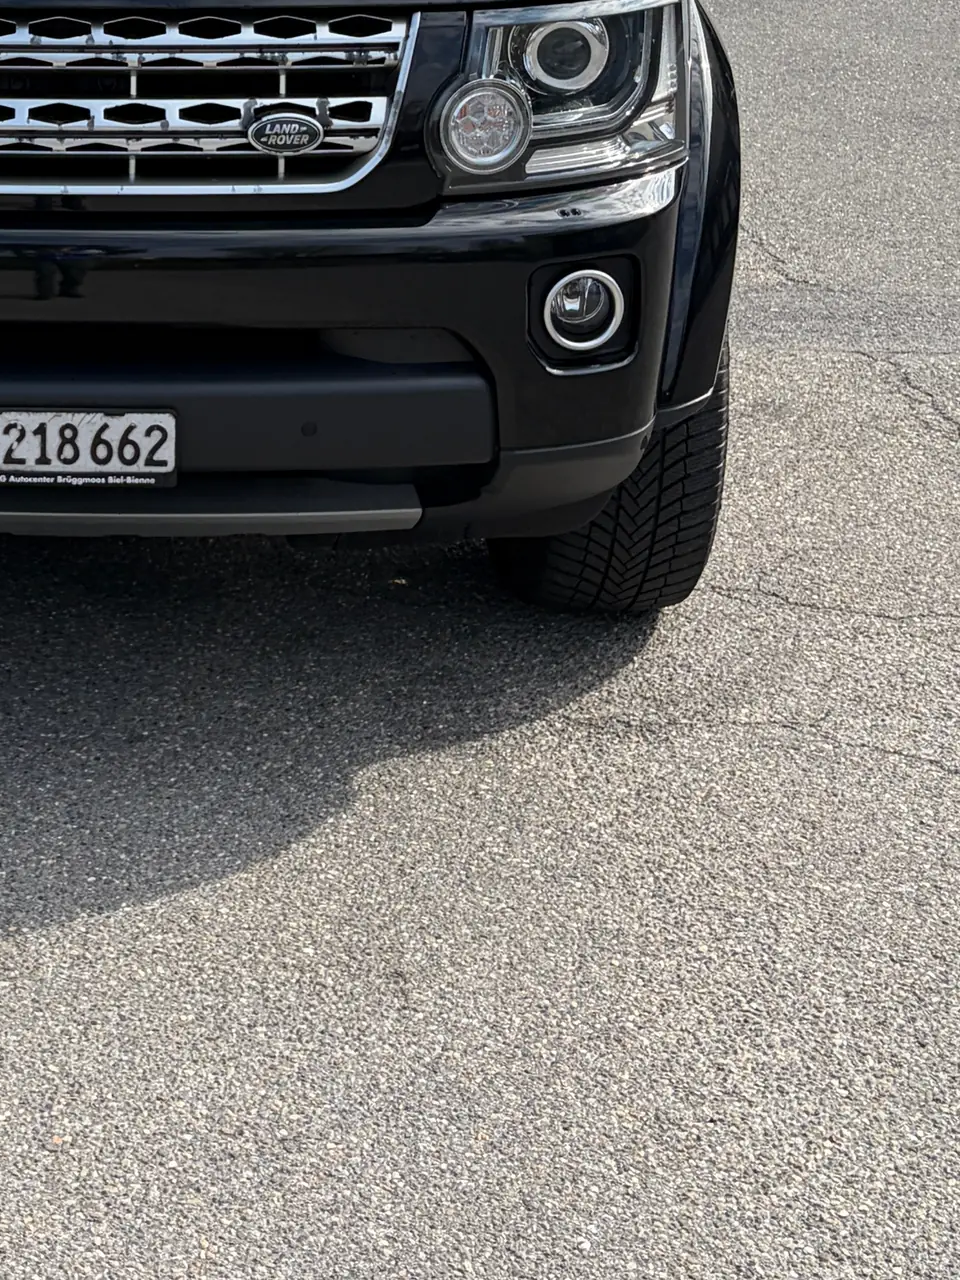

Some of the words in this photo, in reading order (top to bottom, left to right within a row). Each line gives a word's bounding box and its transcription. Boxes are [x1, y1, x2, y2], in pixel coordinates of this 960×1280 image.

[265, 123, 300, 134] LAND
[267, 134, 309, 145] ROVER
[8, 475, 55, 484] Autocenter
[56, 475, 106, 486] Brüggmoos
